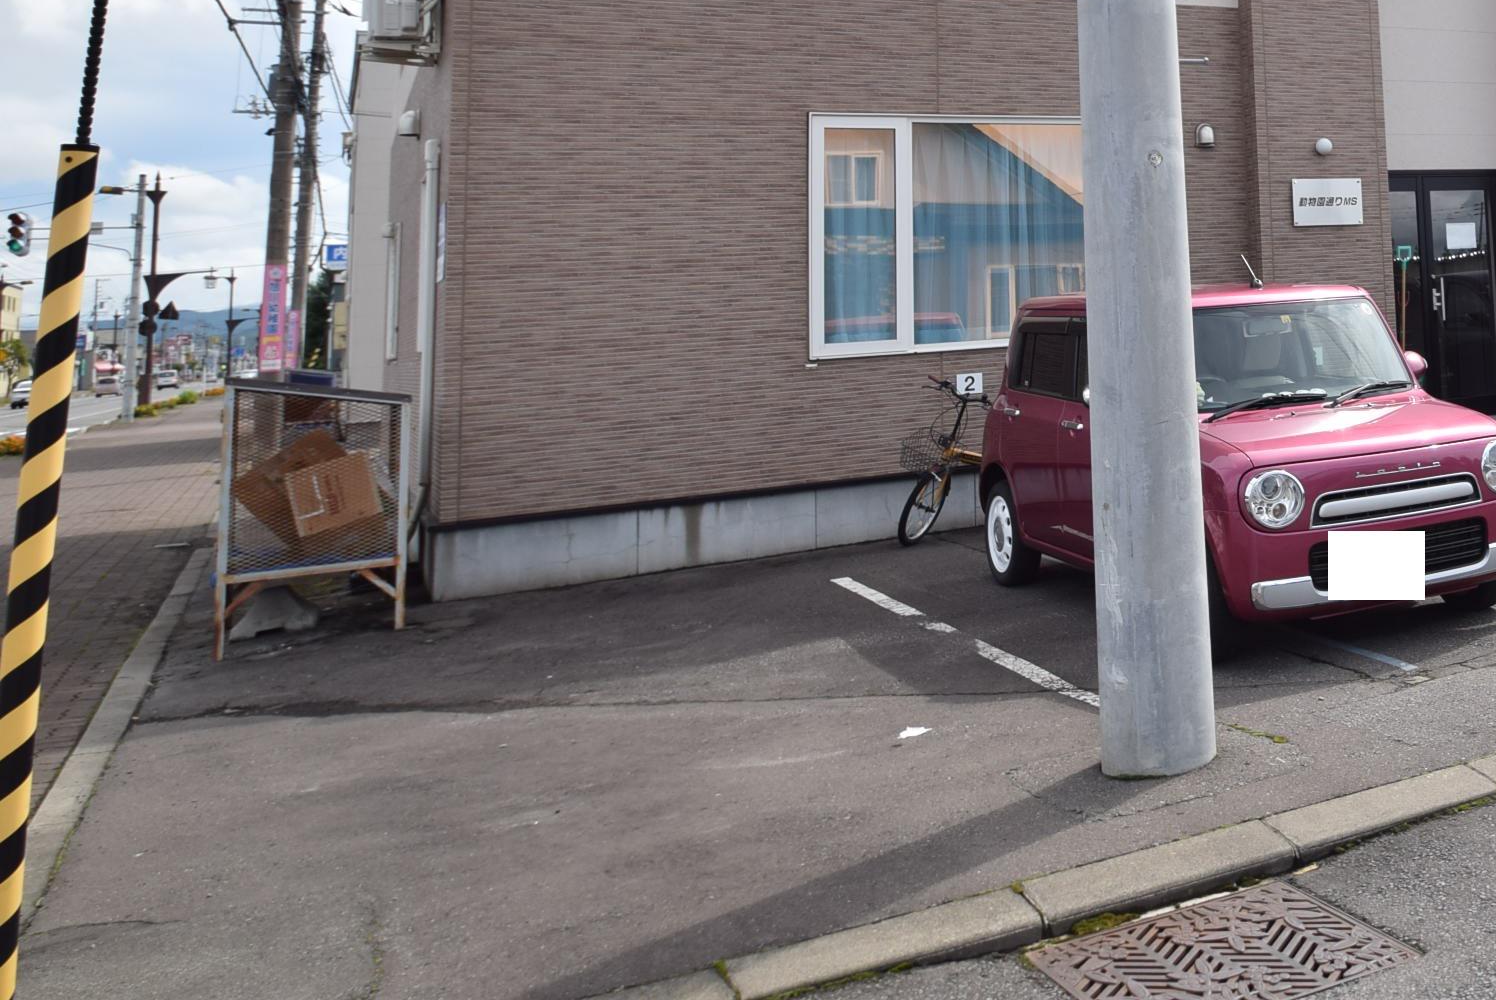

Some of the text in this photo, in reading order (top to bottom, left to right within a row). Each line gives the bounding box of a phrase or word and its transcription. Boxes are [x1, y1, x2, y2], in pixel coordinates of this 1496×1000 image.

[1299, 196, 1358, 207] 動物園通りMS
[964, 375, 975, 391] 2
